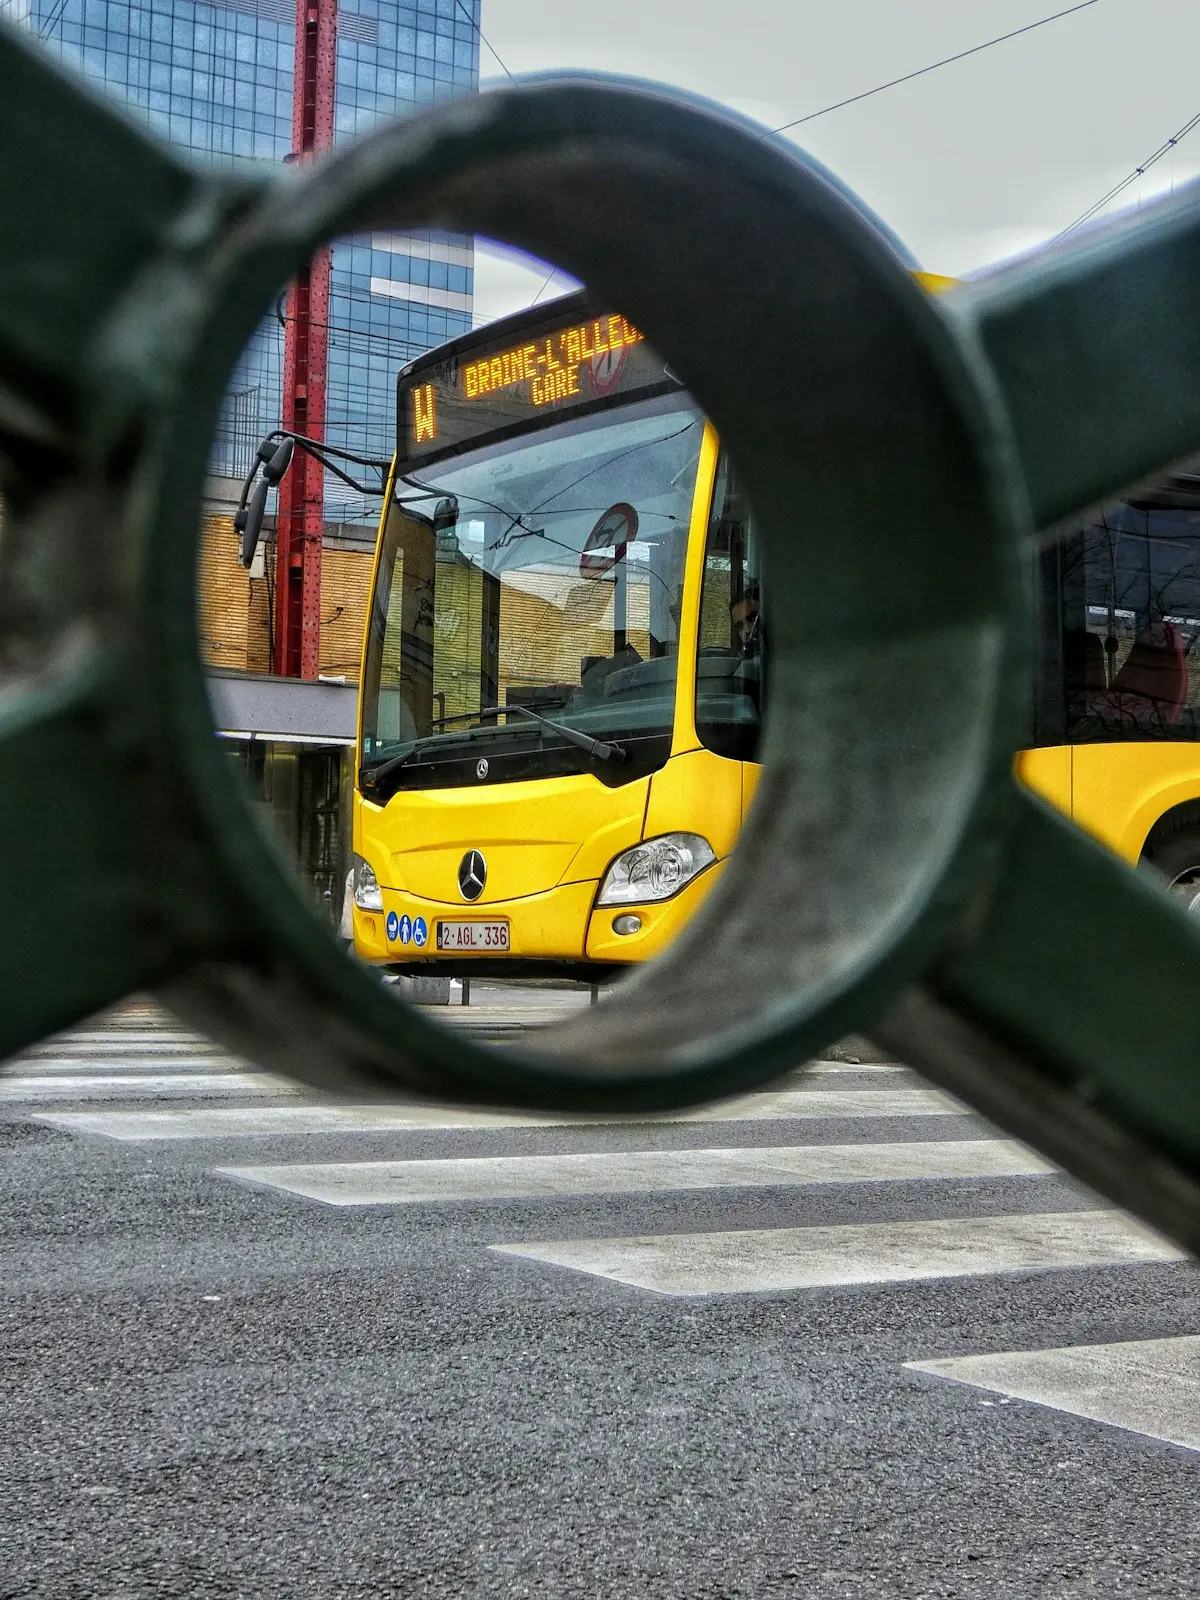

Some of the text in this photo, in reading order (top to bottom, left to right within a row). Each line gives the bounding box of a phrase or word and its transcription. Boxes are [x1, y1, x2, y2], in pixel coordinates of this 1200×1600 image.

[465, 314, 644, 398] BRAINE-L'ALLEU
[532, 364, 580, 405] GARE
[414, 385, 435, 443] W
